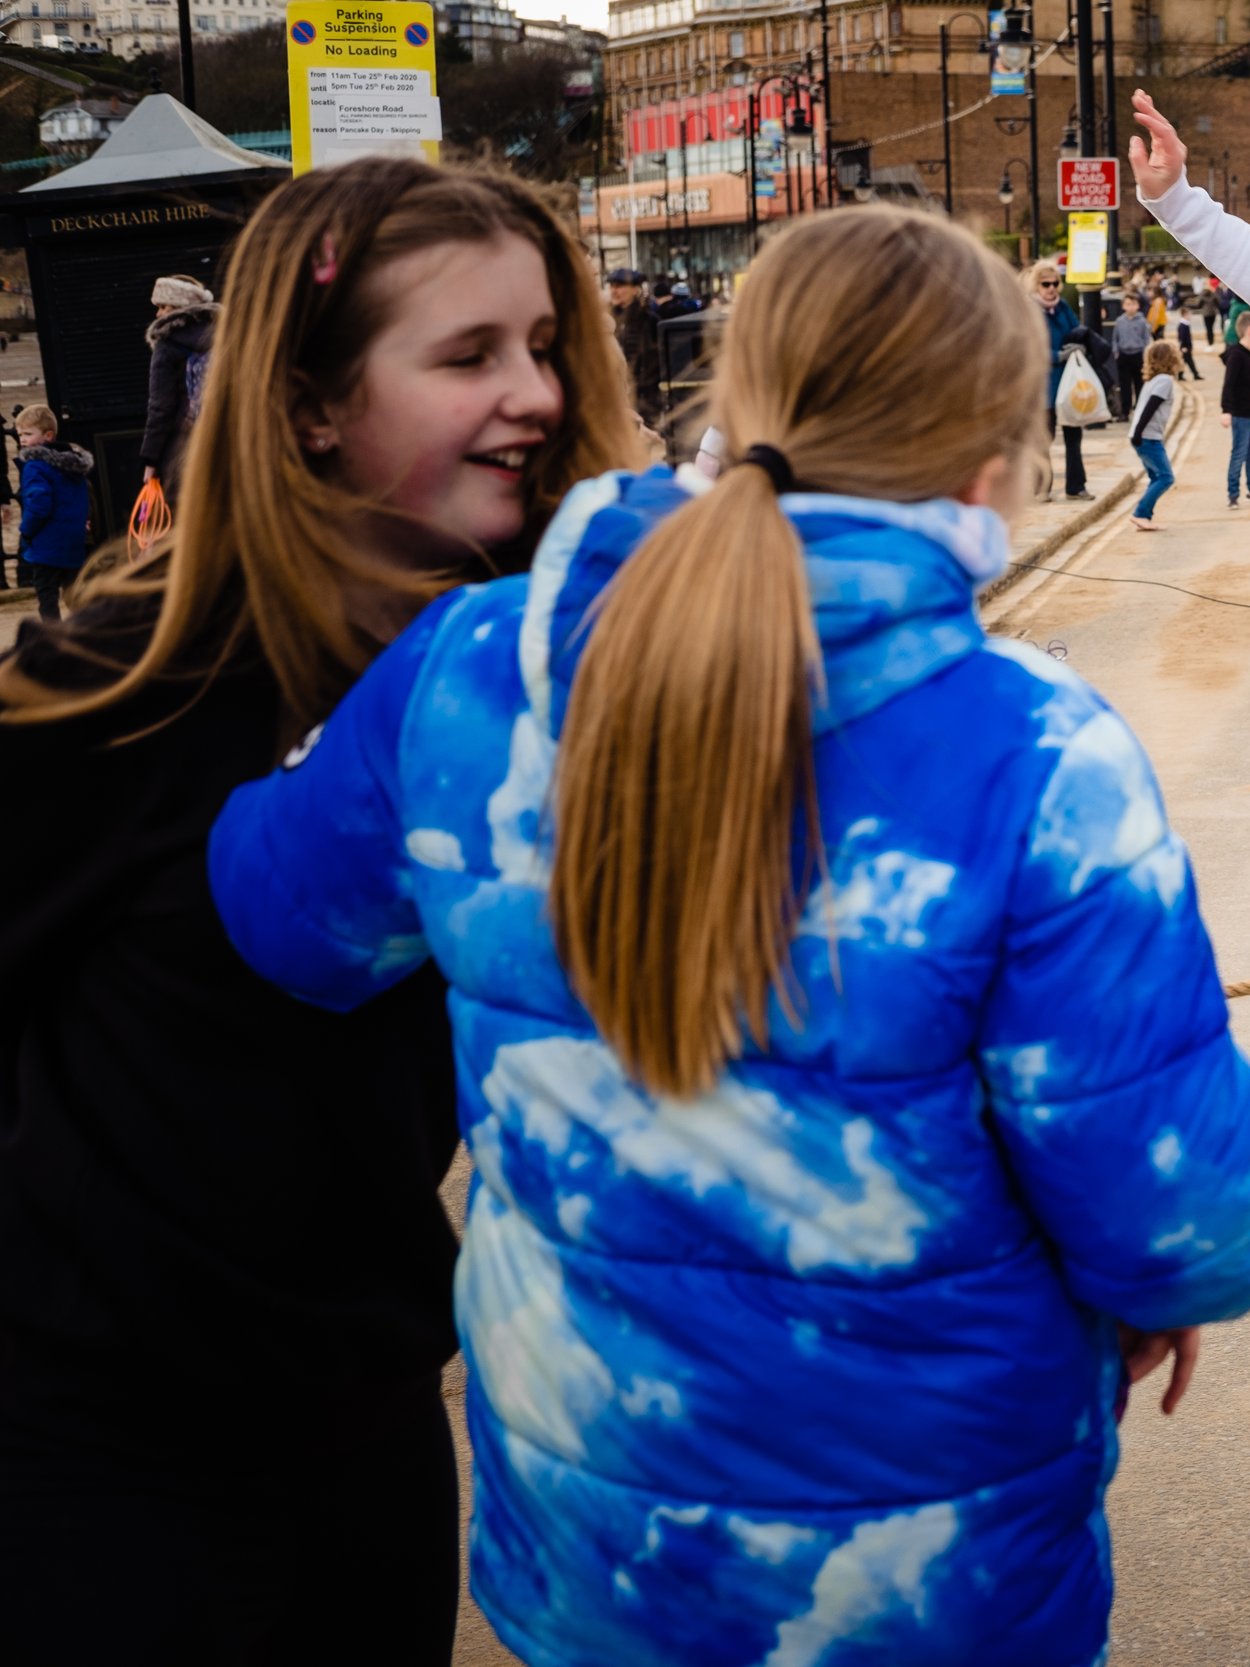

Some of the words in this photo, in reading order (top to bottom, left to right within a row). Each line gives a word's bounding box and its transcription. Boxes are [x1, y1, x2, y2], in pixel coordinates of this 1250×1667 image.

[336, 9, 383, 22] Parking
[324, 22, 397, 34] Suspension
[325, 45, 343, 55] No
[348, 45, 397, 58] Loading
[384, 73, 398, 81] Feb
[331, 83, 347, 91] 5pm
[391, 127, 421, 135] Skipping
[1074, 162, 1103, 172] NEW
[1070, 172, 1106, 184] ROAD
[1064, 183, 1112, 195] LAYOUT
[1068, 195, 1110, 206] AHEAD
[51, 208, 160, 233] DECKCHAIR
[165, 203, 211, 222] HIRE
